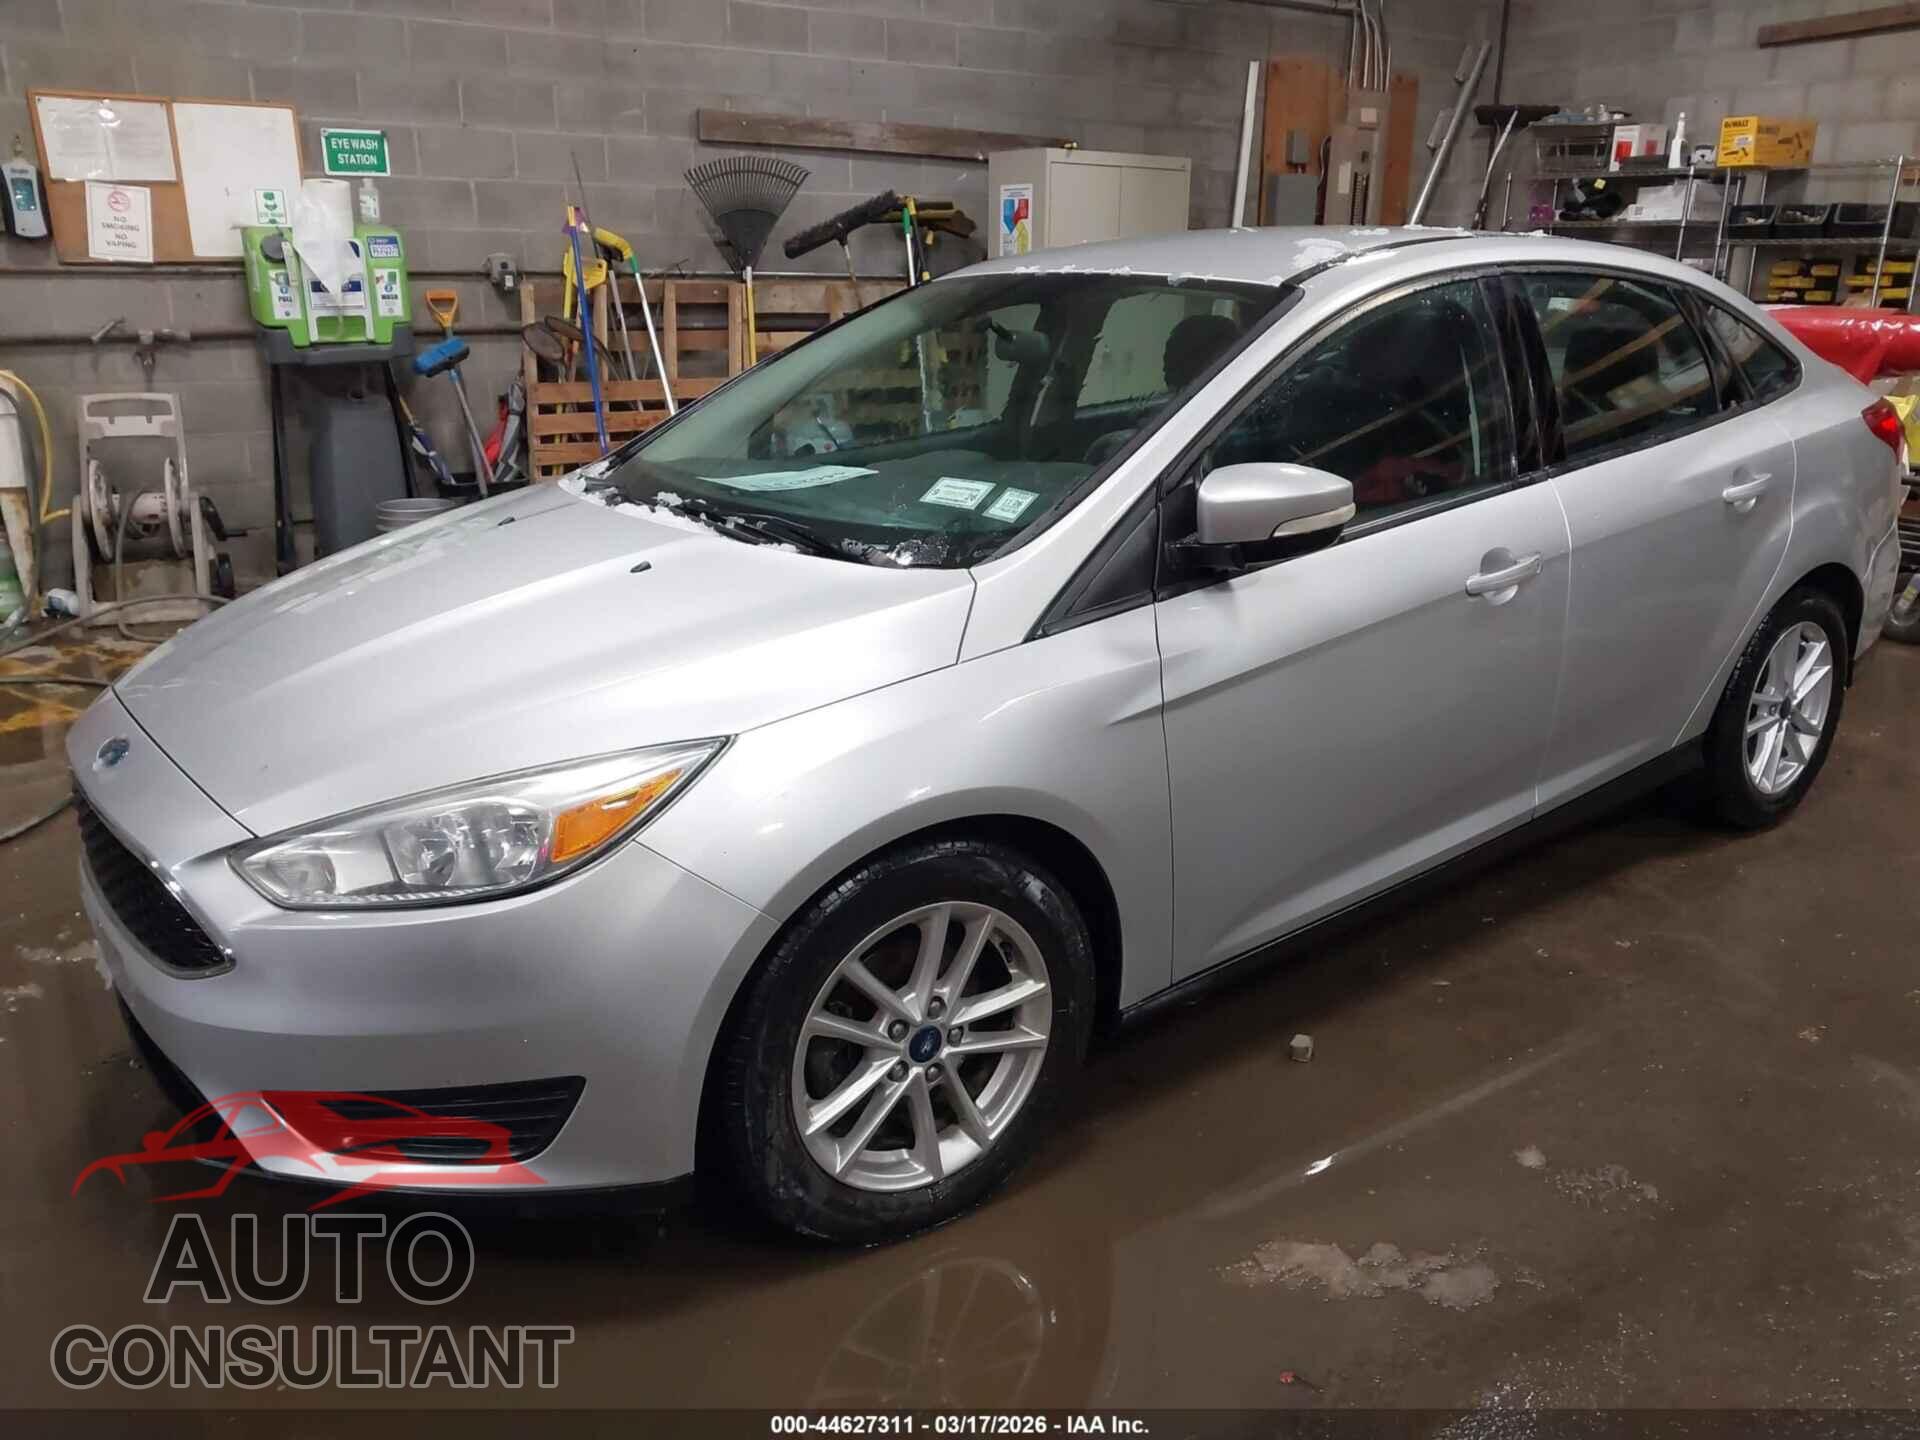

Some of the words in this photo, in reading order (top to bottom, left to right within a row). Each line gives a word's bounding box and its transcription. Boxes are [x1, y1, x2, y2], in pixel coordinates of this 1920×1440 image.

[337, 153, 378, 166] STATION
[113, 215, 128, 223] NO
[101, 221, 141, 232] SMOKING
[115, 232, 129, 240] NO
[105, 240, 138, 249] VAPING
